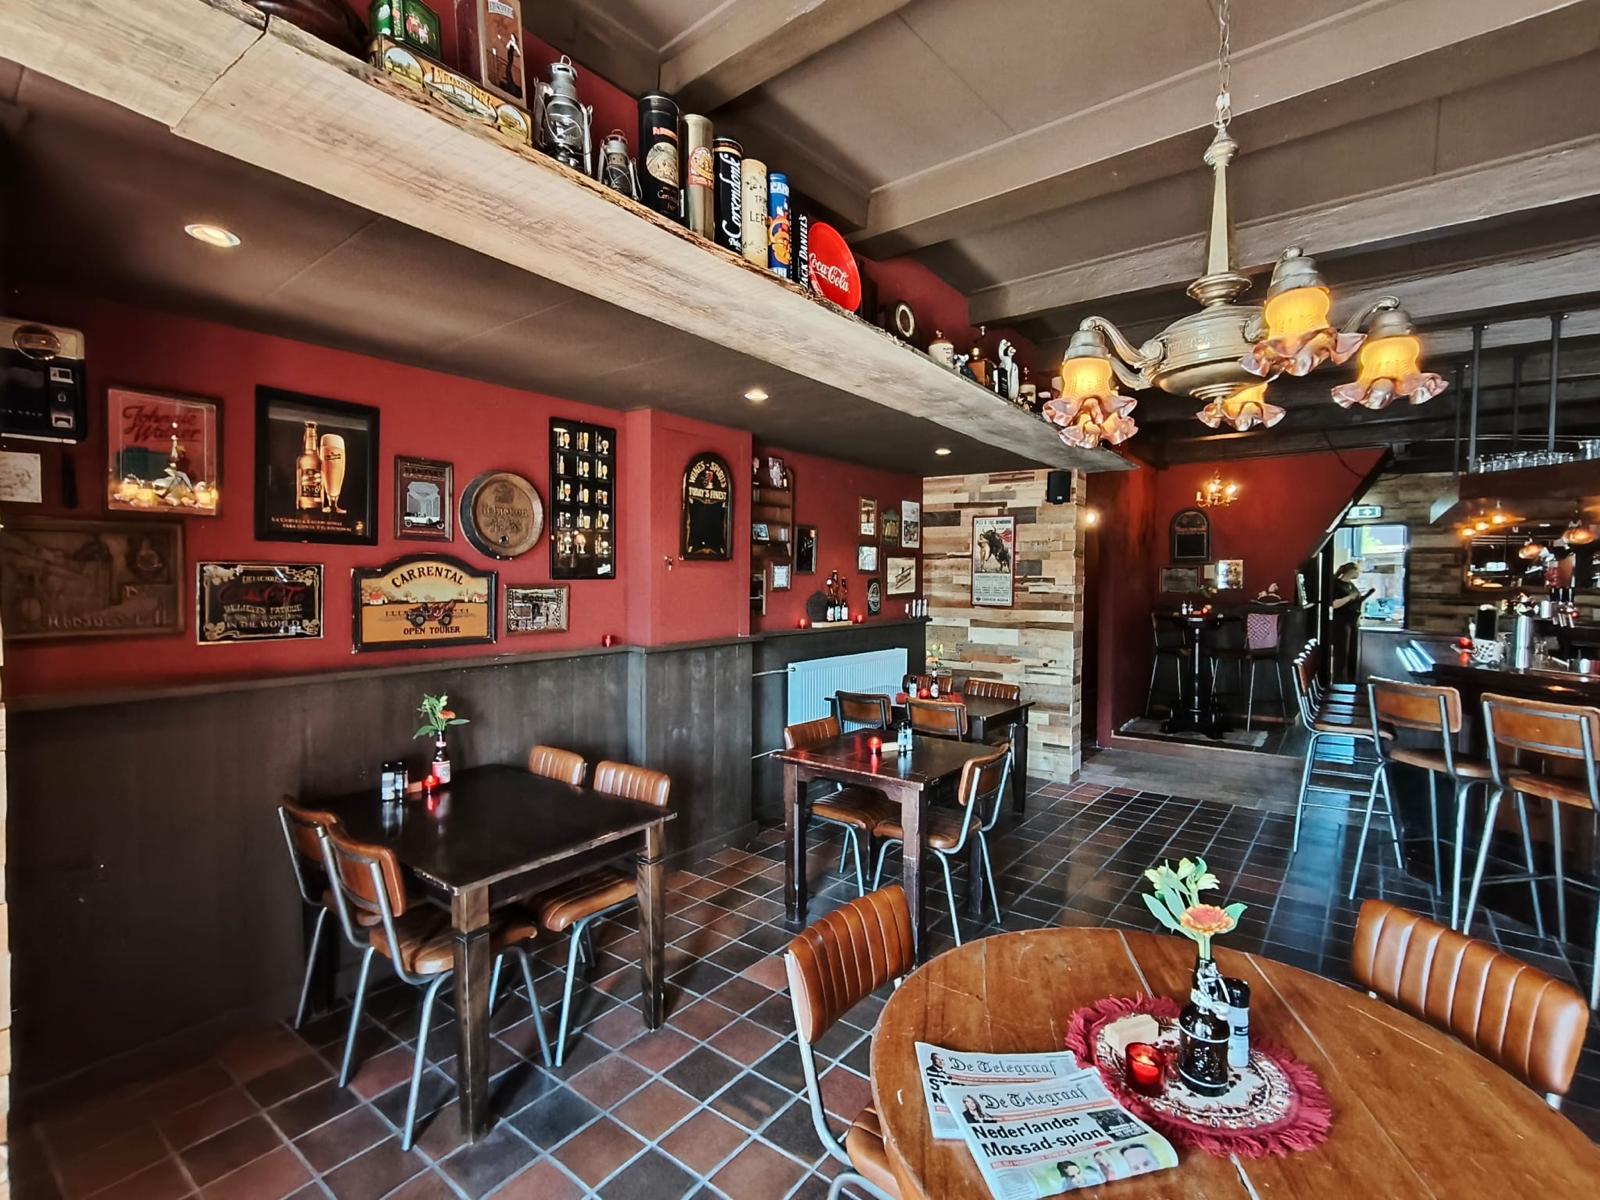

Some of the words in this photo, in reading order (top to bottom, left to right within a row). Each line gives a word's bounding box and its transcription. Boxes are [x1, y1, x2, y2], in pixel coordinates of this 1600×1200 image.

[719, 153, 741, 239] Corsendonk
[799, 262, 809, 289] JACK
[809, 252, 849, 292] Coca-Cola
[403, 627, 426, 635] OPEN
[949, 1057, 973, 1073] De
[976, 1060, 1057, 1076] Telegraaf
[982, 1092, 1007, 1110] De
[1008, 1084, 1088, 1107] Telegraaf
[972, 1115, 1080, 1140] Nederlander
[982, 1127, 1104, 1157] Mossad-spion
